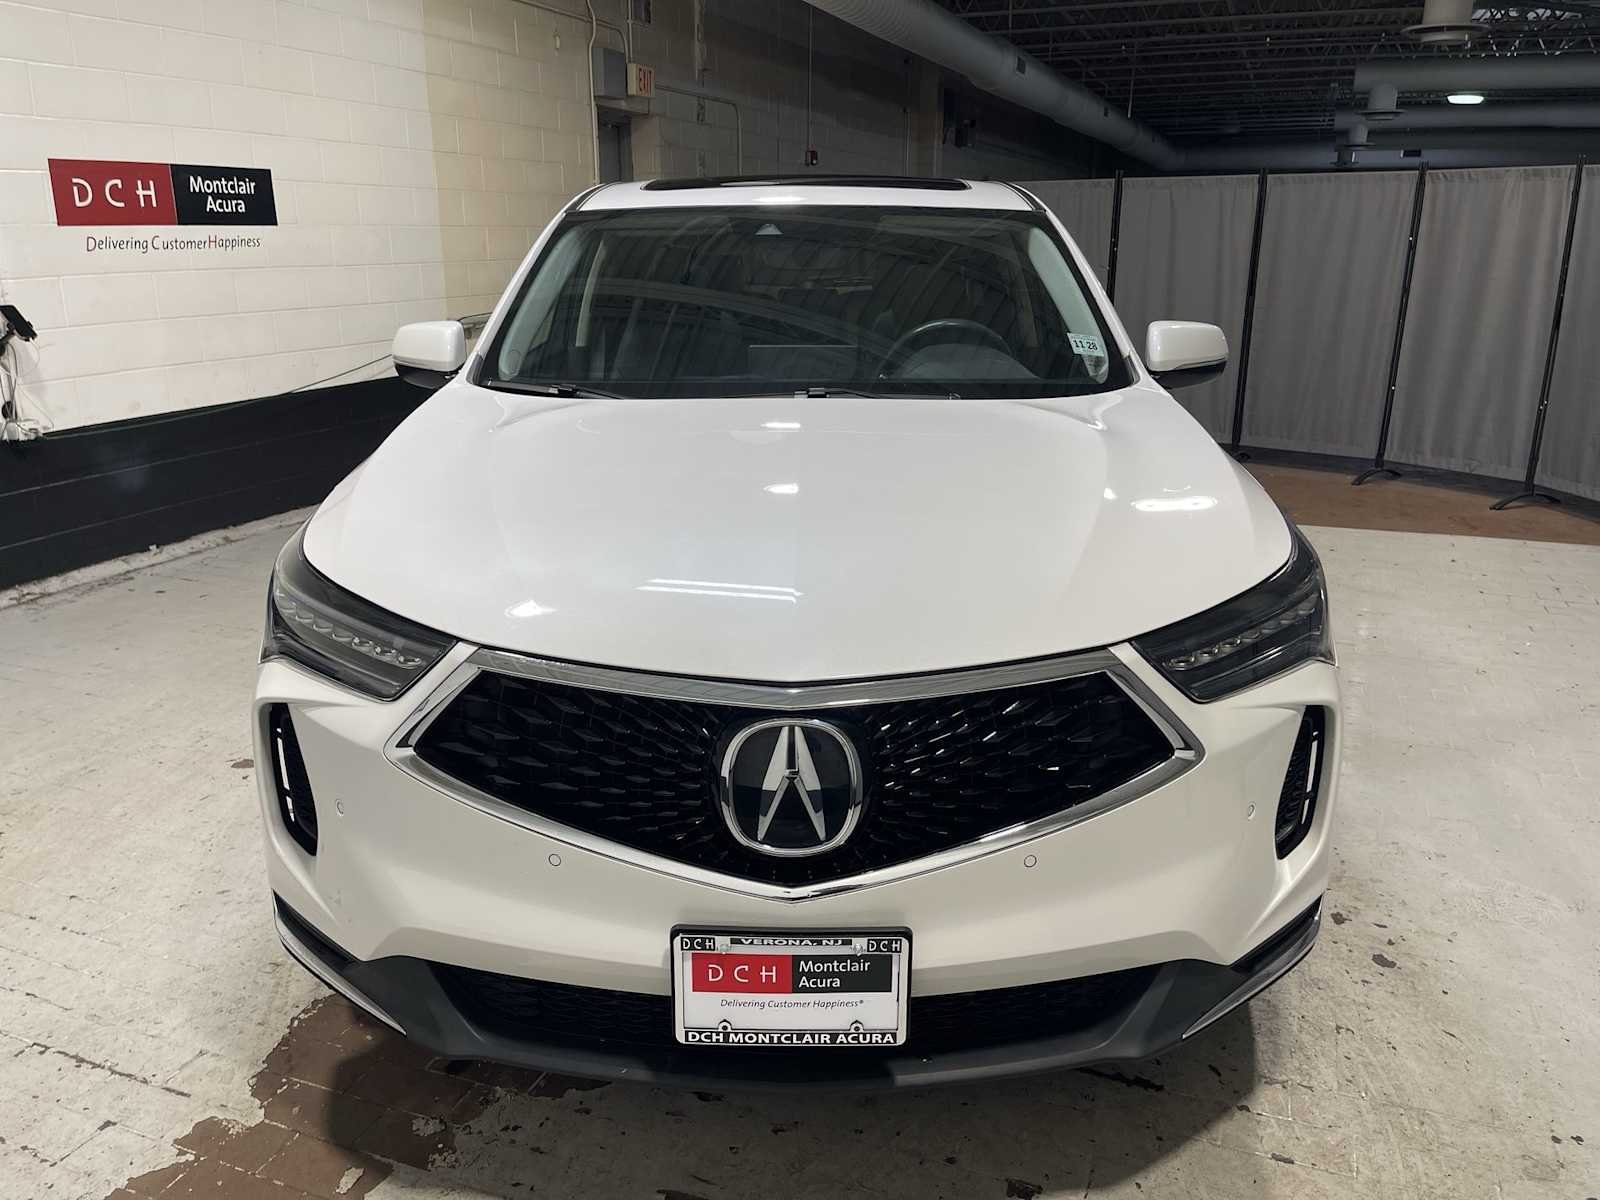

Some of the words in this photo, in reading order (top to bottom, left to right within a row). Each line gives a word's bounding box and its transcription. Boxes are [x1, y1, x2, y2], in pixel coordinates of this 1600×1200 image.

[189, 175, 256, 195] Montclair
[206, 196, 246, 213] Acura
[86, 236, 149, 254] Delivering
[151, 235, 208, 251] Customer
[208, 234, 261, 250] Happiness
[740, 938, 818, 946] VERONA,
[824, 938, 842, 946] NJ
[799, 960, 871, 973] Montclair
[798, 976, 841, 988] Acura
[720, 999, 765, 1009] Delivering
[767, 1000, 811, 1008] Customer
[688, 1032, 724, 1042] DCH
[728, 1033, 831, 1044] MONTCLAIR
[837, 1034, 894, 1044] ACURA
